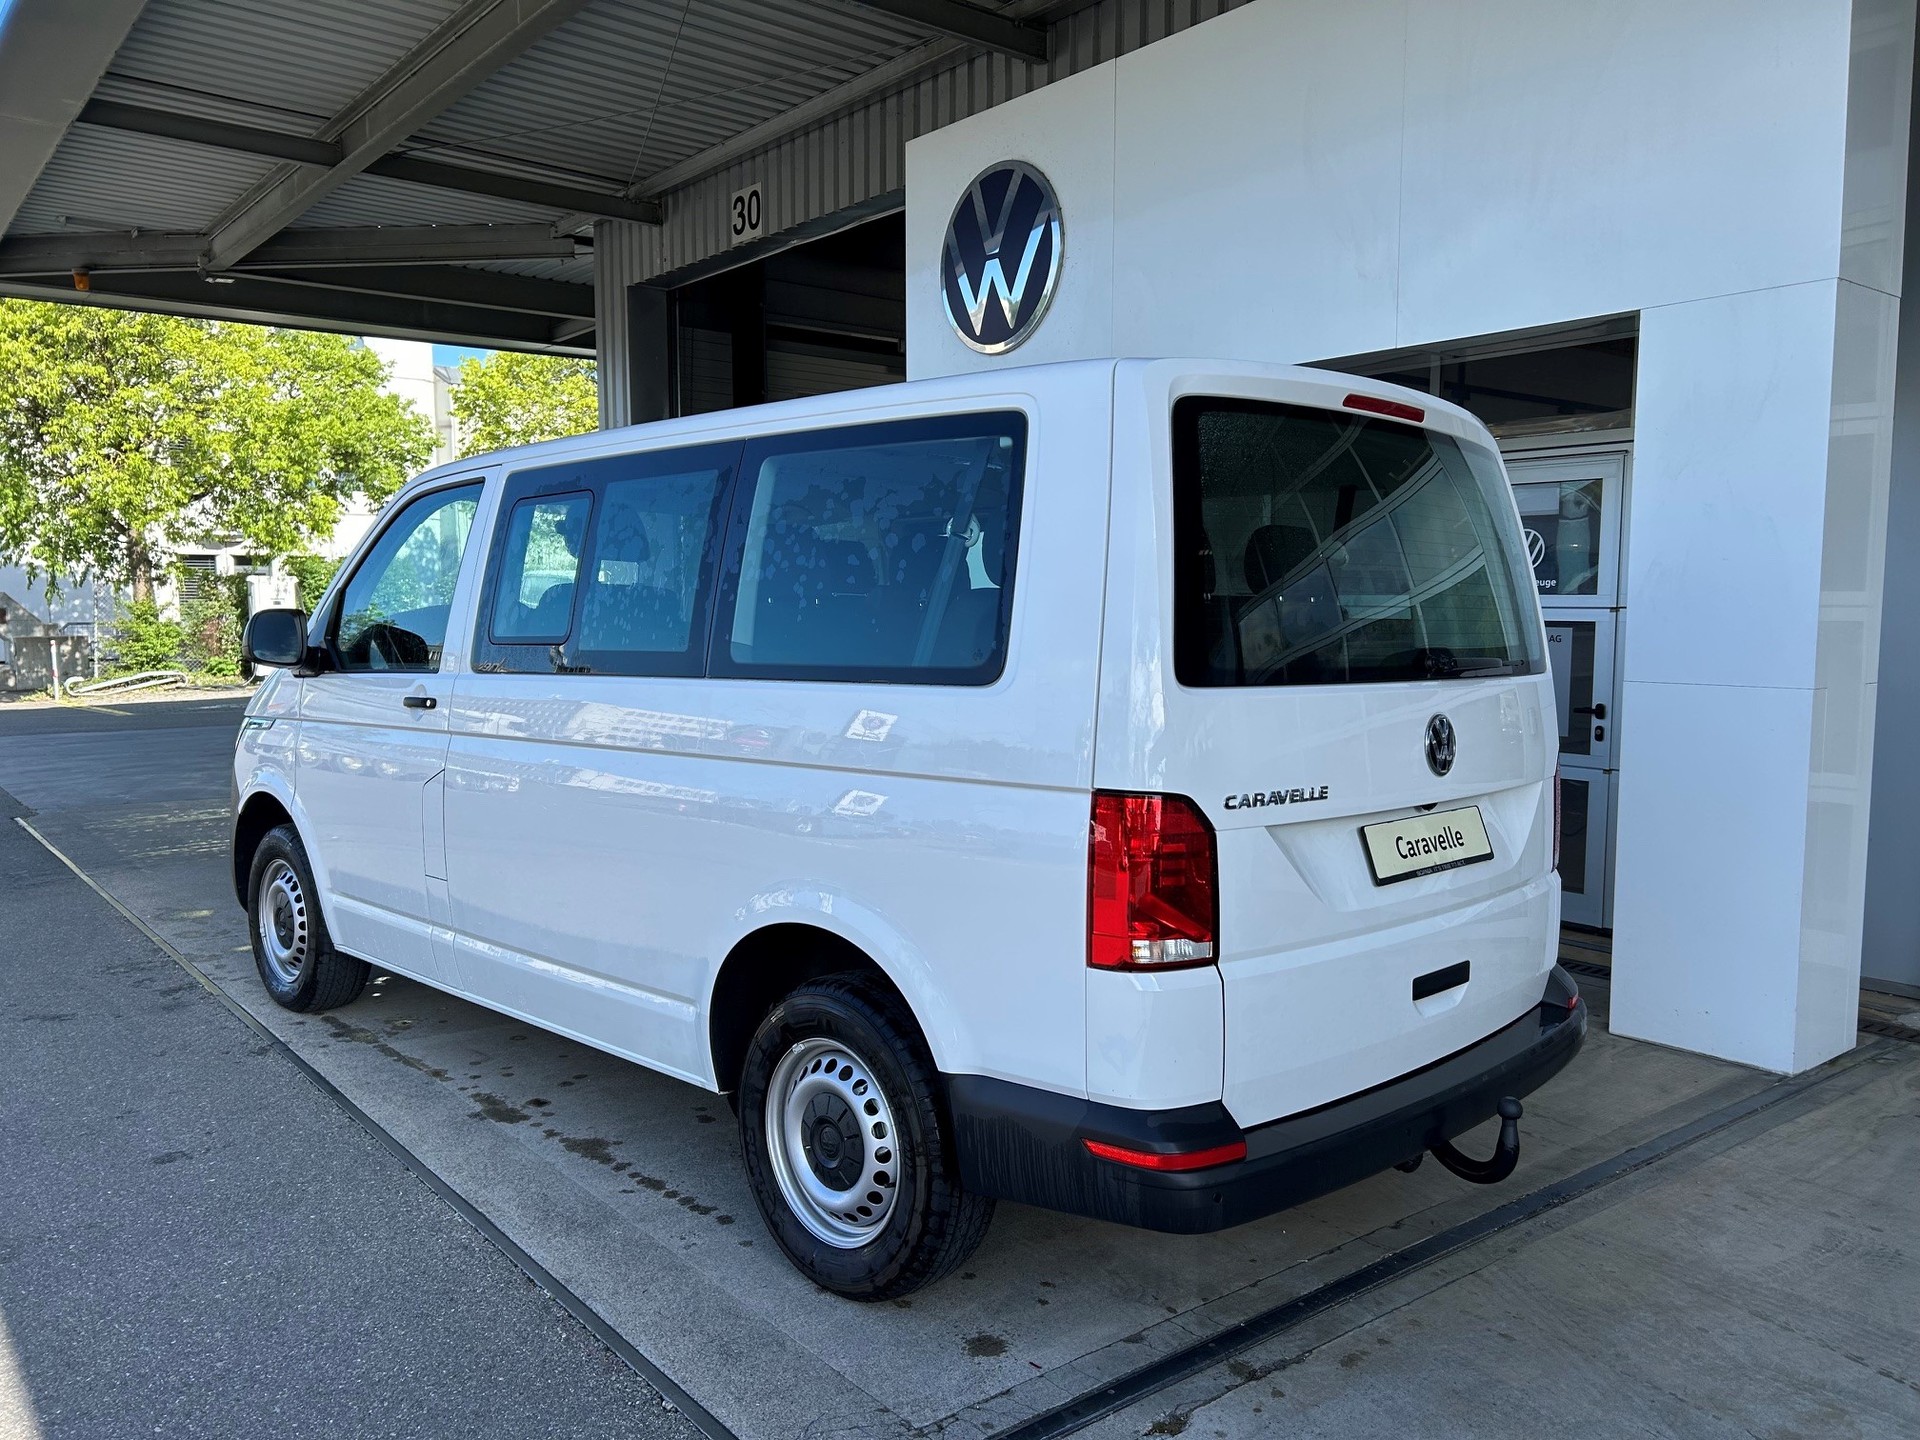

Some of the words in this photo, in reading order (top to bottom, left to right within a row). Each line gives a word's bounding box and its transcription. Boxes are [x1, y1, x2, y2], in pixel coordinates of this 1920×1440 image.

[732, 189, 761, 236] 30
[1224, 786, 1329, 810] CARAVELLE
[1395, 826, 1465, 860] Caravelle
